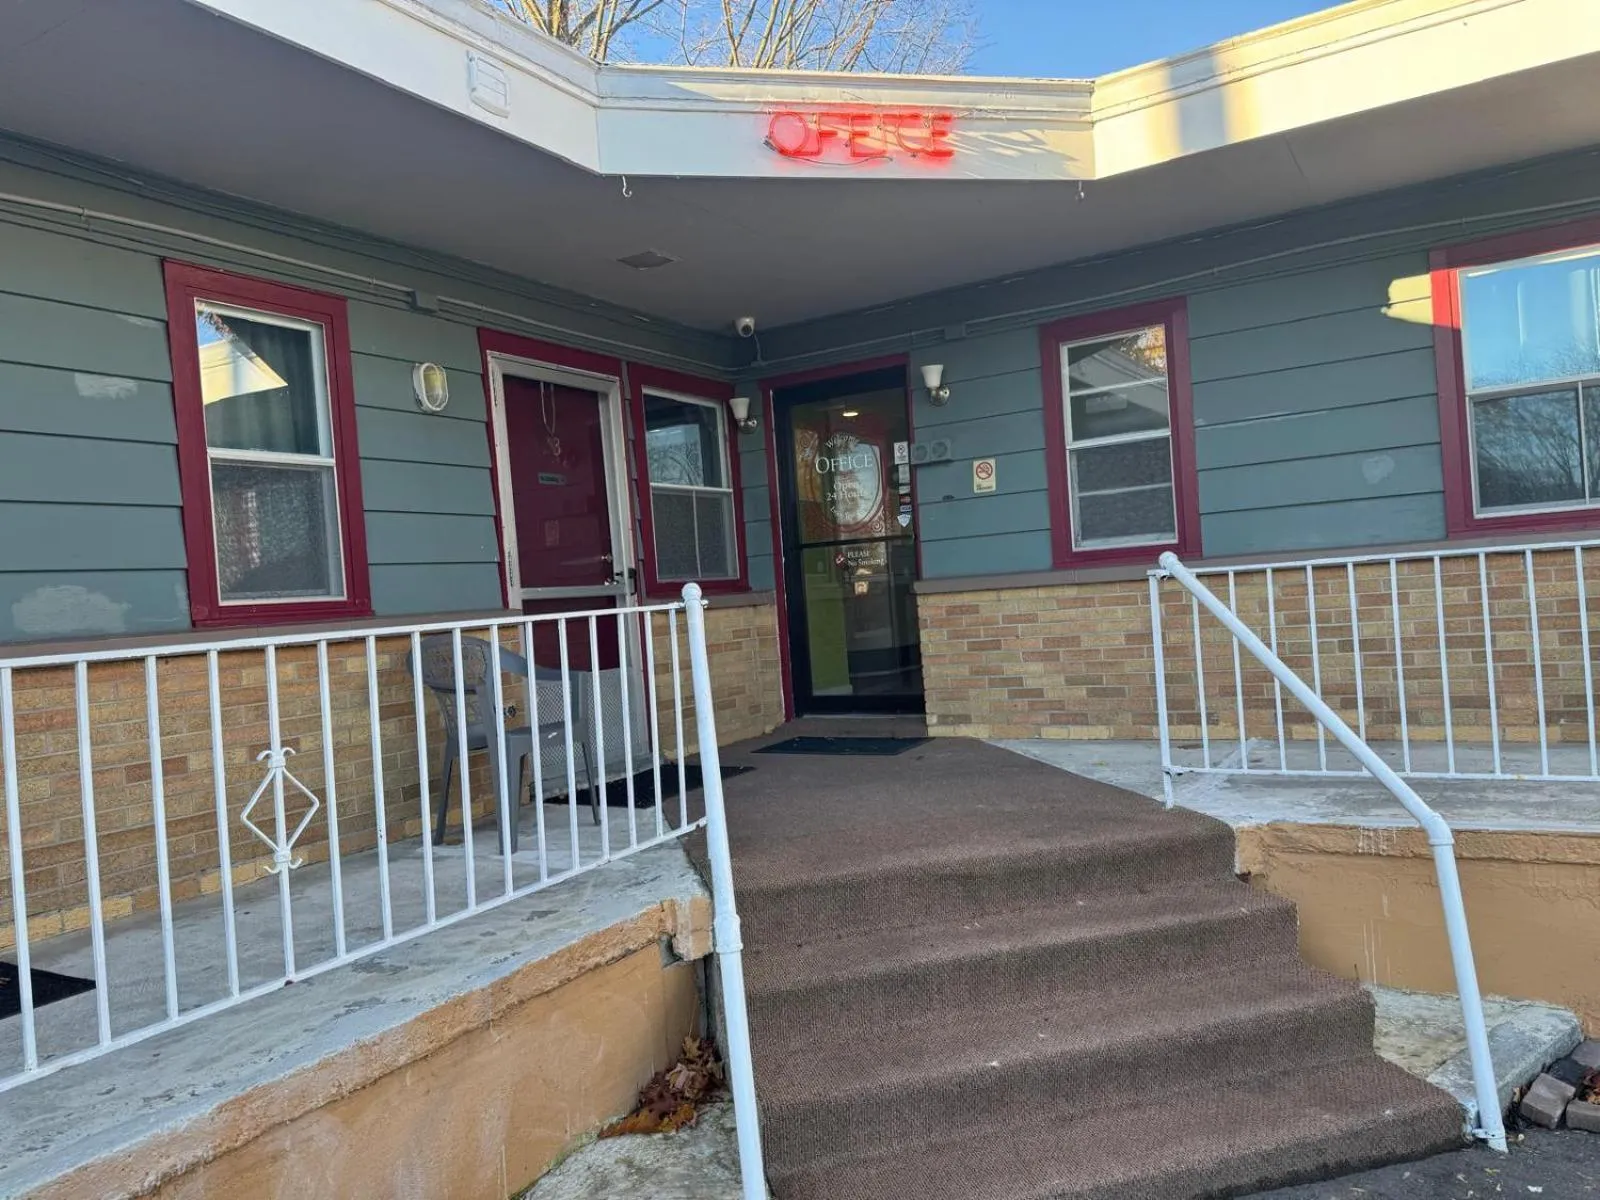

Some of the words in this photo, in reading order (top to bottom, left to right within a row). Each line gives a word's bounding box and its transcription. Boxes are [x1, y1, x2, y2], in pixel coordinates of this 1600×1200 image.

[769, 111, 954, 157] OFFICE
[815, 454, 873, 474] OFFICE
[847, 549, 870, 558] PLEASE
